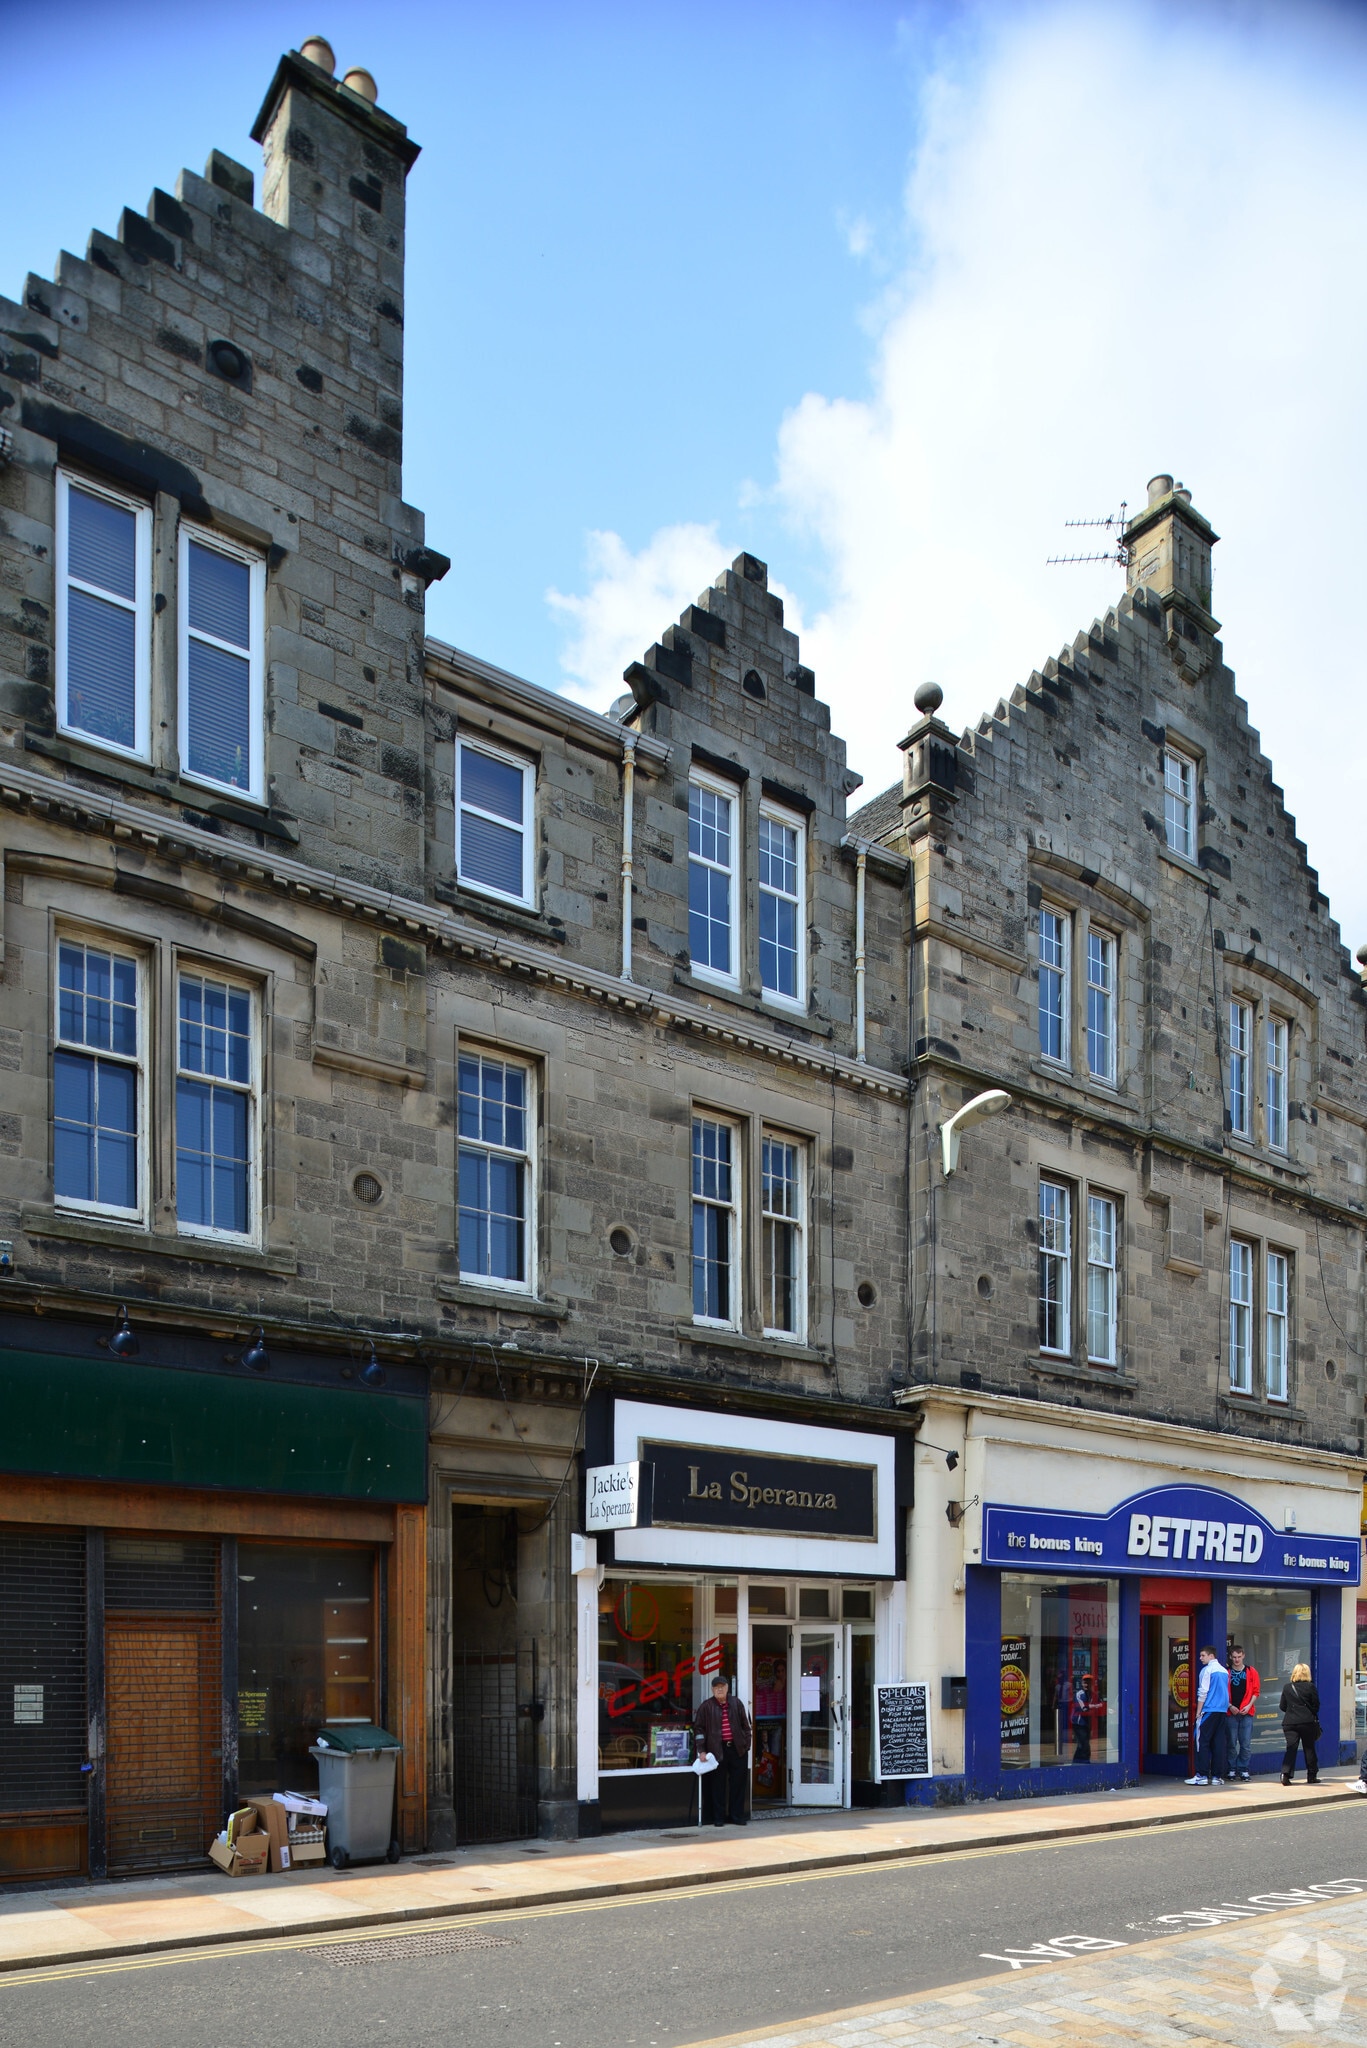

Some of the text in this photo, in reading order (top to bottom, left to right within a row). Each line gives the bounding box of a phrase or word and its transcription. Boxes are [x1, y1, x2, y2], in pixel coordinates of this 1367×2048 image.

[592, 1471, 634, 1499] Jackie's
[688, 1466, 837, 1510] La Speranza
[590, 1500, 635, 1523] La Speranza
[1007, 1532, 1103, 1556] the bonus king
[1127, 1513, 1264, 1564] BETFRED
[1283, 1553, 1350, 1572] the bonus king
[1009, 1642, 1026, 1652] SLOTS
[1173, 1645, 1184, 1653] PLAY
[880, 1687, 925, 1700] SPECIALS
[1003, 1690, 1019, 1698] SPINS
[1009, 1717, 1029, 1728] WHOLE
[978, 1934, 1129, 1970] BAY
